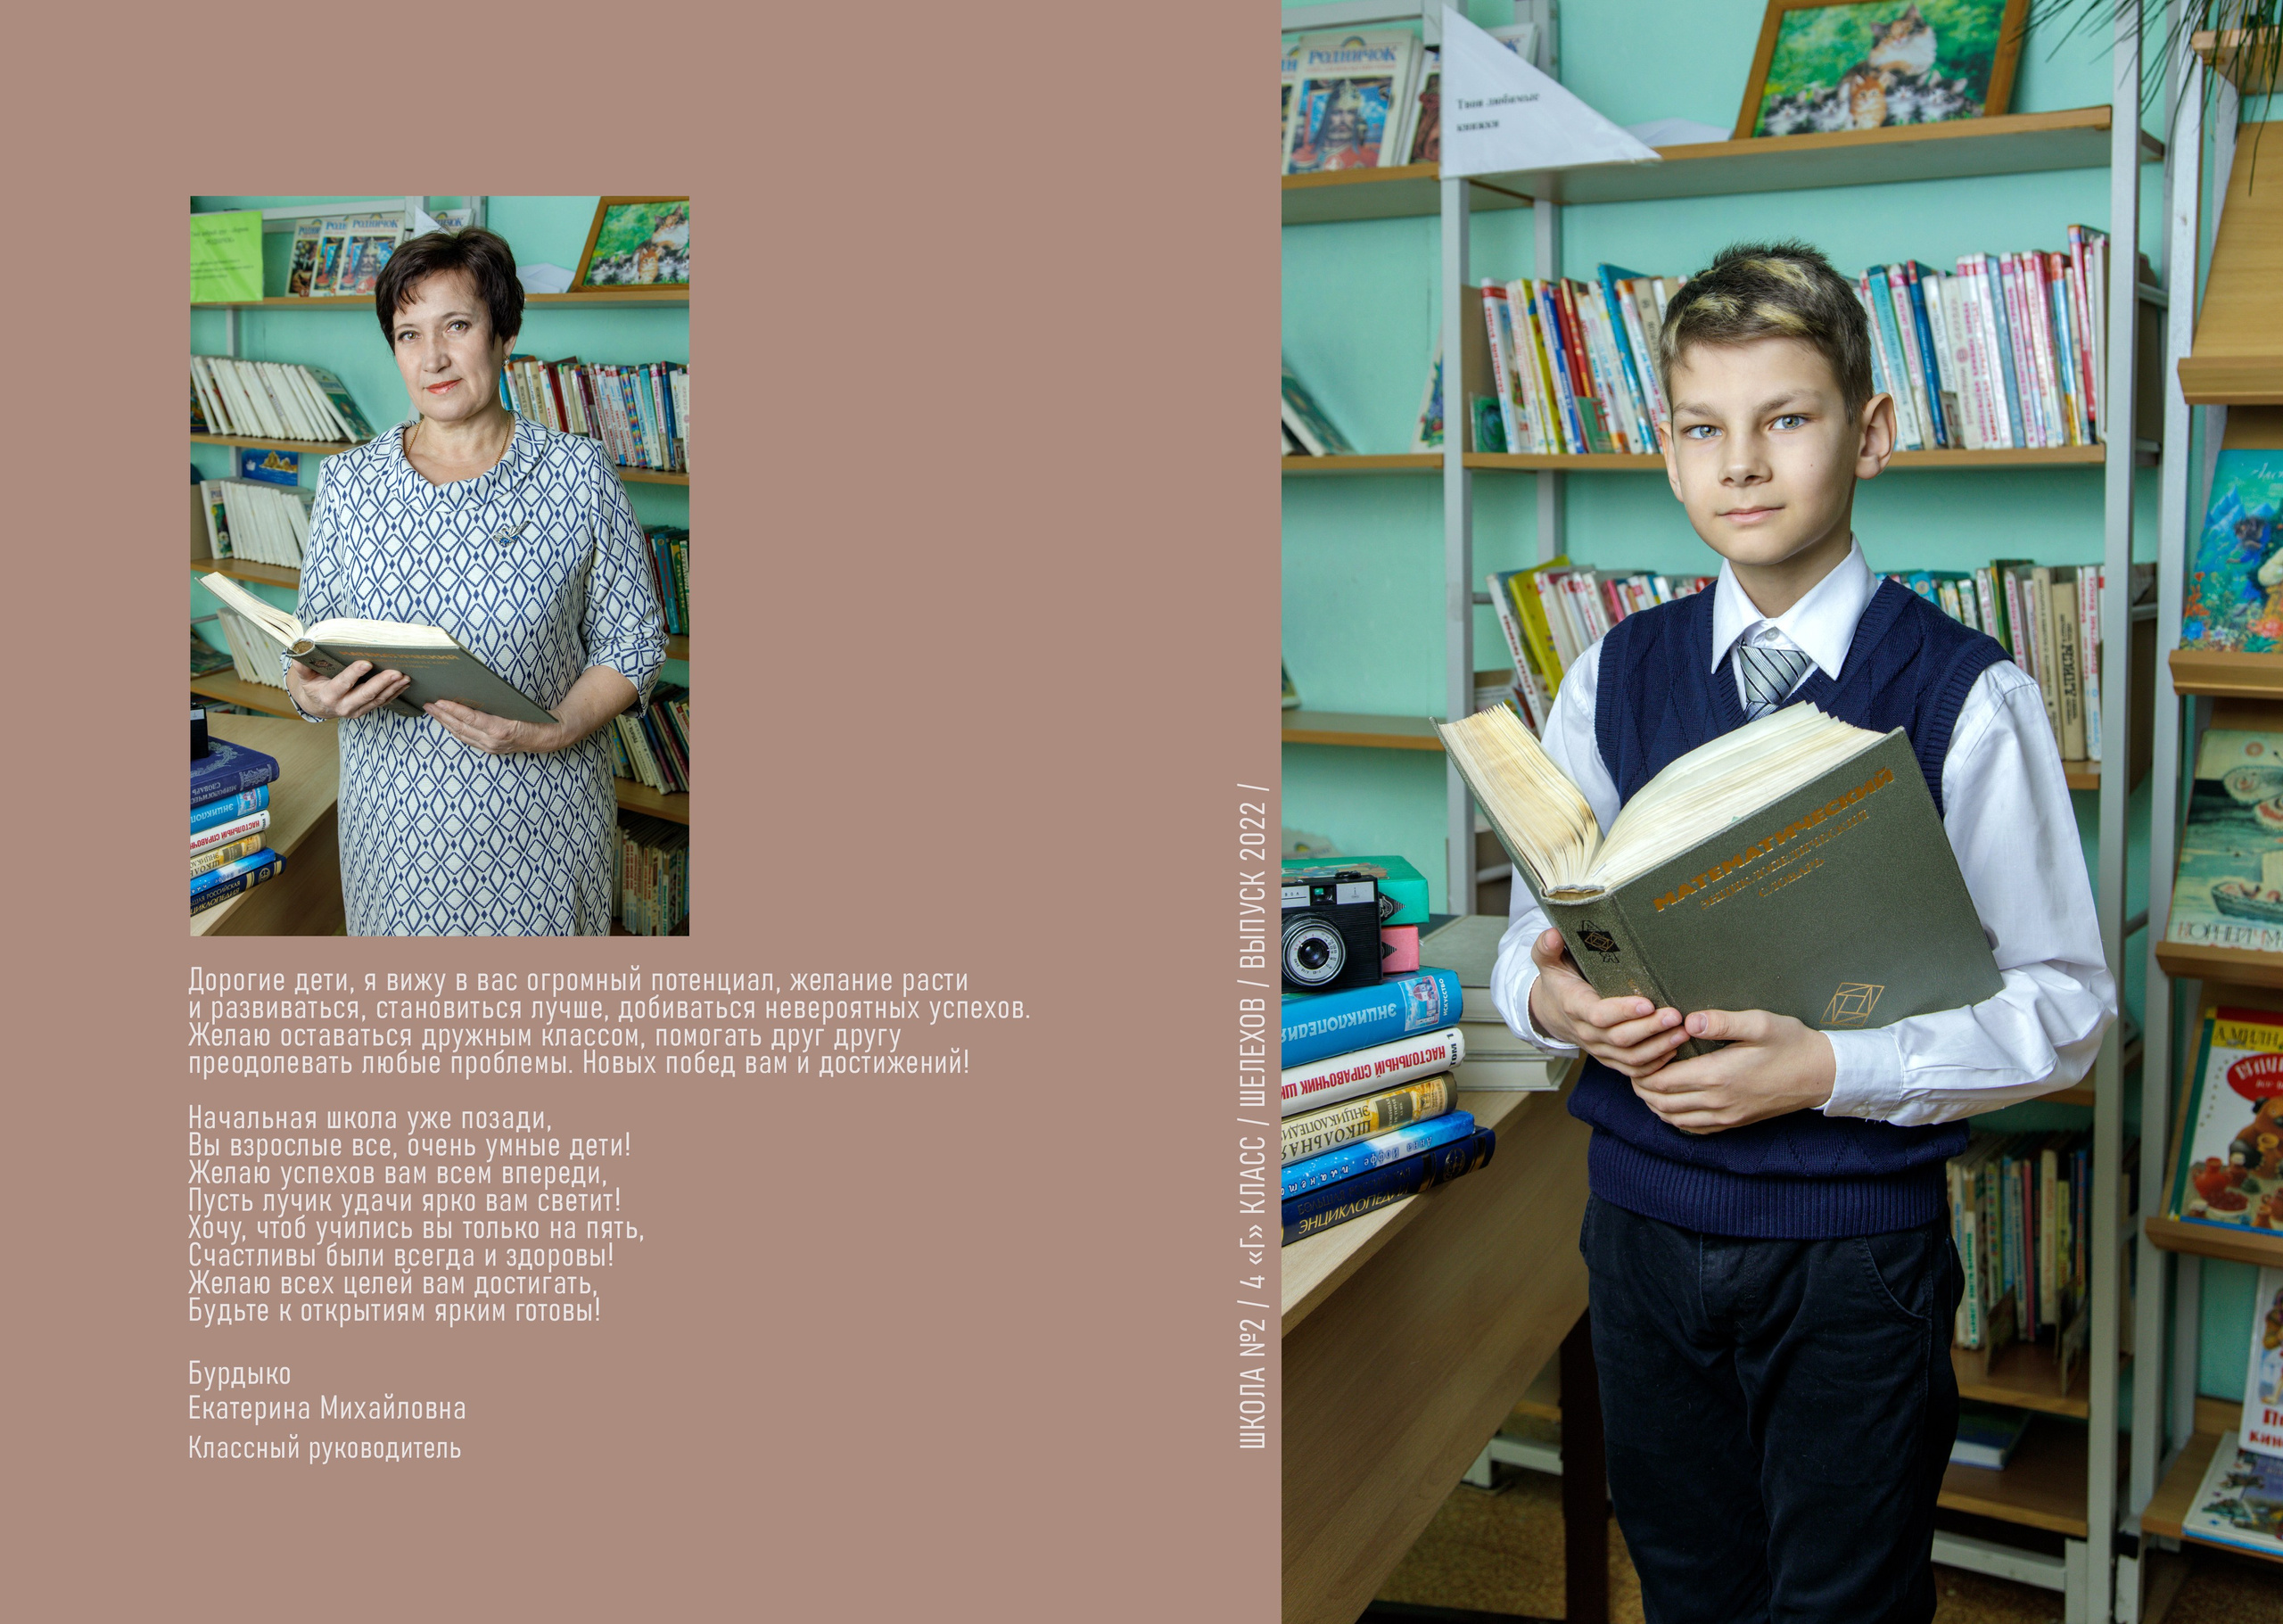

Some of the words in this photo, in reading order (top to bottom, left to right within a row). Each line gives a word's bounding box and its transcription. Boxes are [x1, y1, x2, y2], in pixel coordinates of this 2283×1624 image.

[1486, 92, 1540, 108] любимые
[1456, 120, 1499, 133] книжки
[221, 820, 260, 839] НАСТОЛЬНЫЙ
[1653, 766, 1896, 912] МАТЕМАТИЧЕСКИЙ
[1701, 808, 1869, 911] ЭНЦИКЛОПЕДИЧЕСКИЙ
[1758, 857, 1826, 899] СЛОВАРЬ
[1438, 978, 1448, 1017] ИСКУССТВО
[1375, 1045, 1446, 1078] НАСТОЛЬНЫЙ
[1300, 1065, 1372, 1095] СПРАВОЧНИК
[1364, 1147, 1399, 1167] Иоффе
[1406, 1136, 1432, 1152] Анна
[1298, 1189, 1346, 1216] БОЛЬШАЯ
